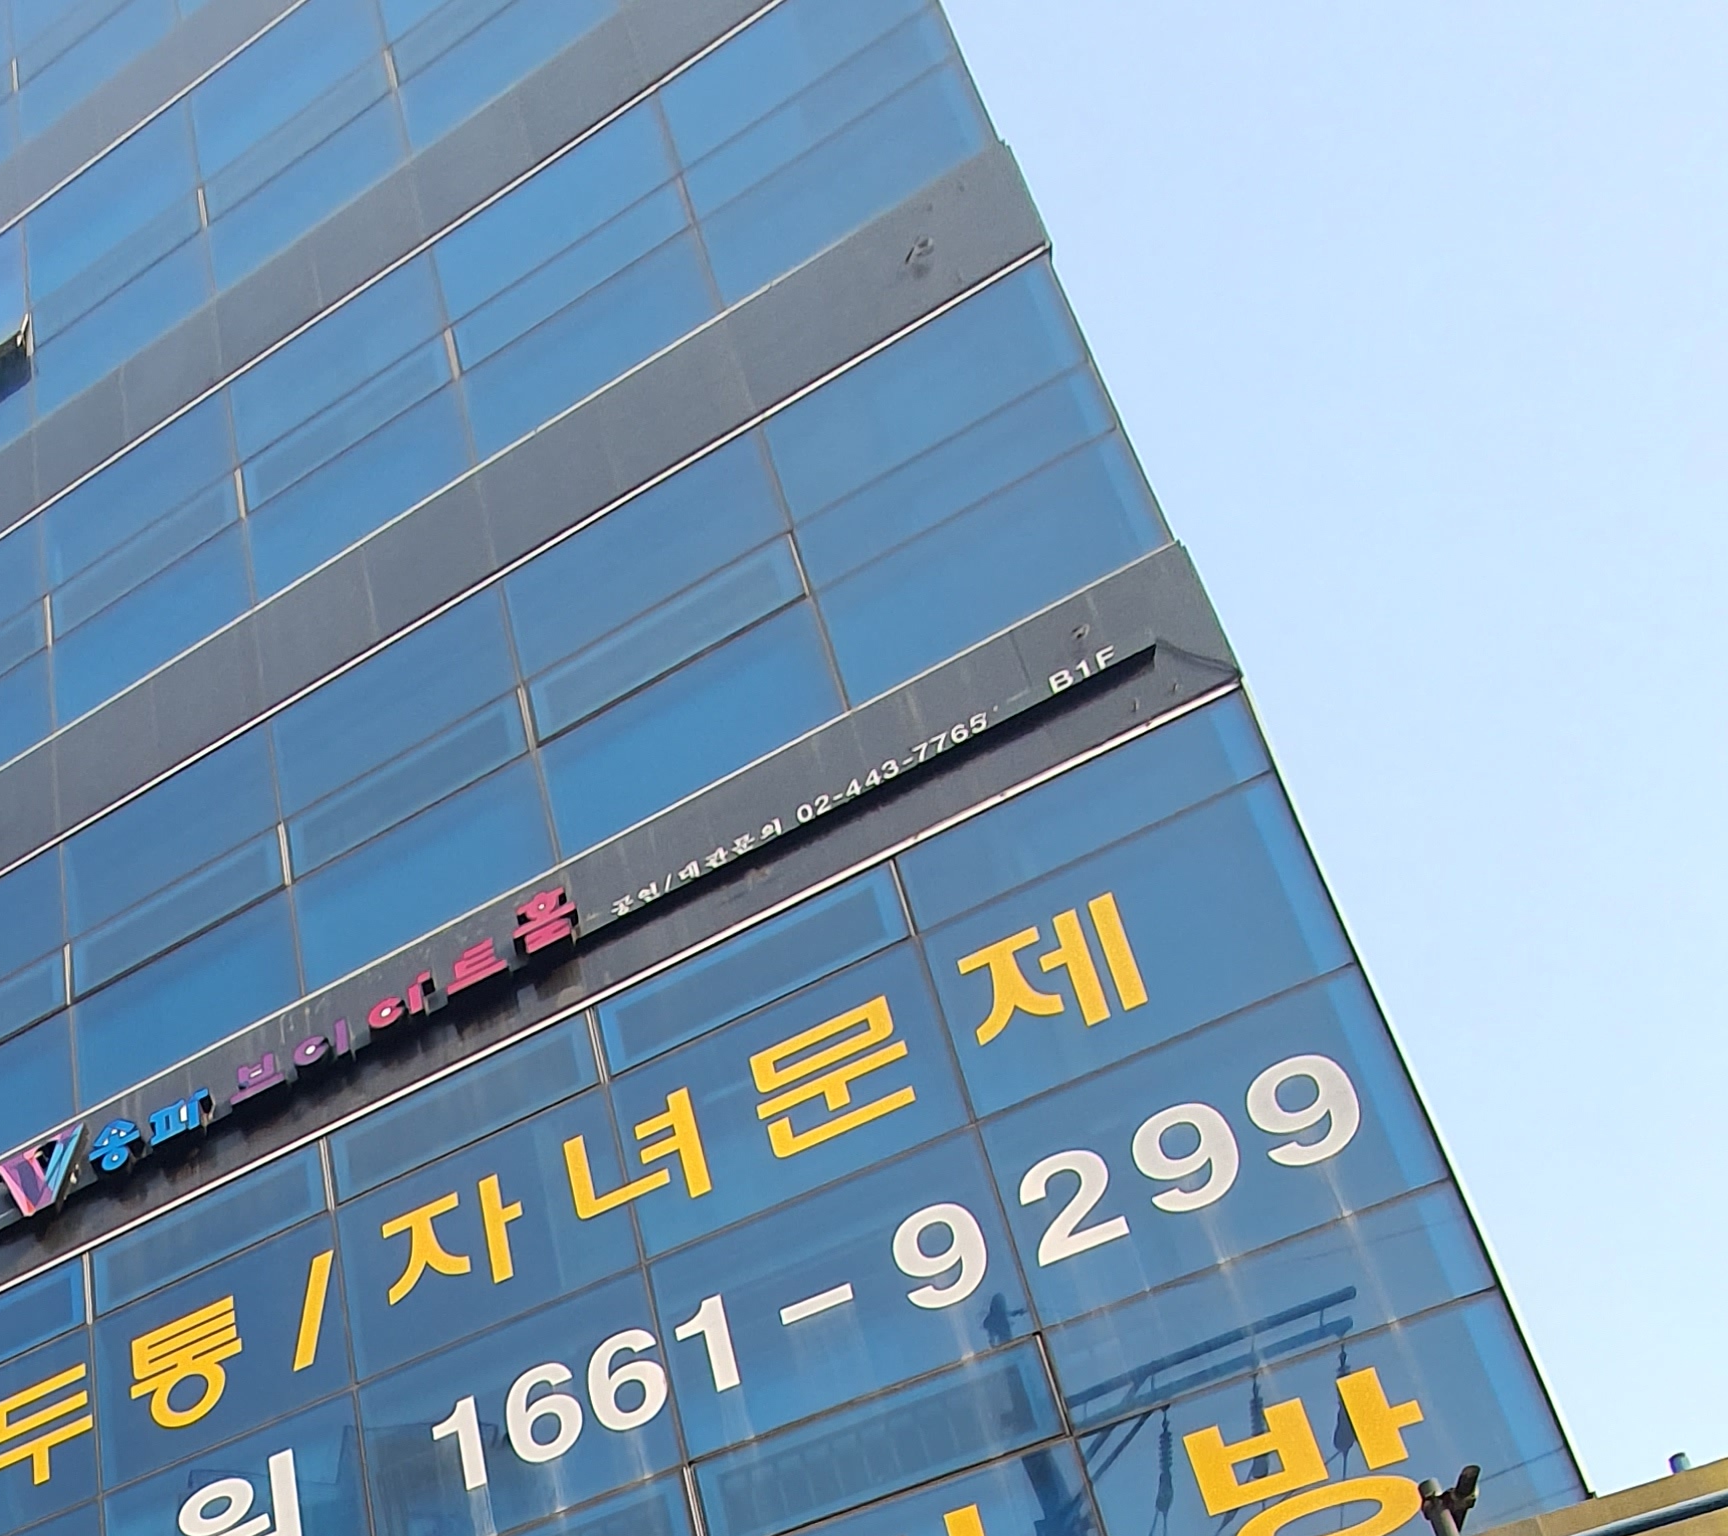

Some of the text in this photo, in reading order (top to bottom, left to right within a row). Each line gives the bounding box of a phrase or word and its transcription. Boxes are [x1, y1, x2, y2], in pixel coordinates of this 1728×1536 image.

[89, 1088, 210, 1172] 송파
[368, 887, 576, 1029] 아트홀
[796, 711, 989, 824] 02-443-7765
[1048, 645, 1118, 695] B1F
[431, 1053, 1363, 1491] 1661-9299
